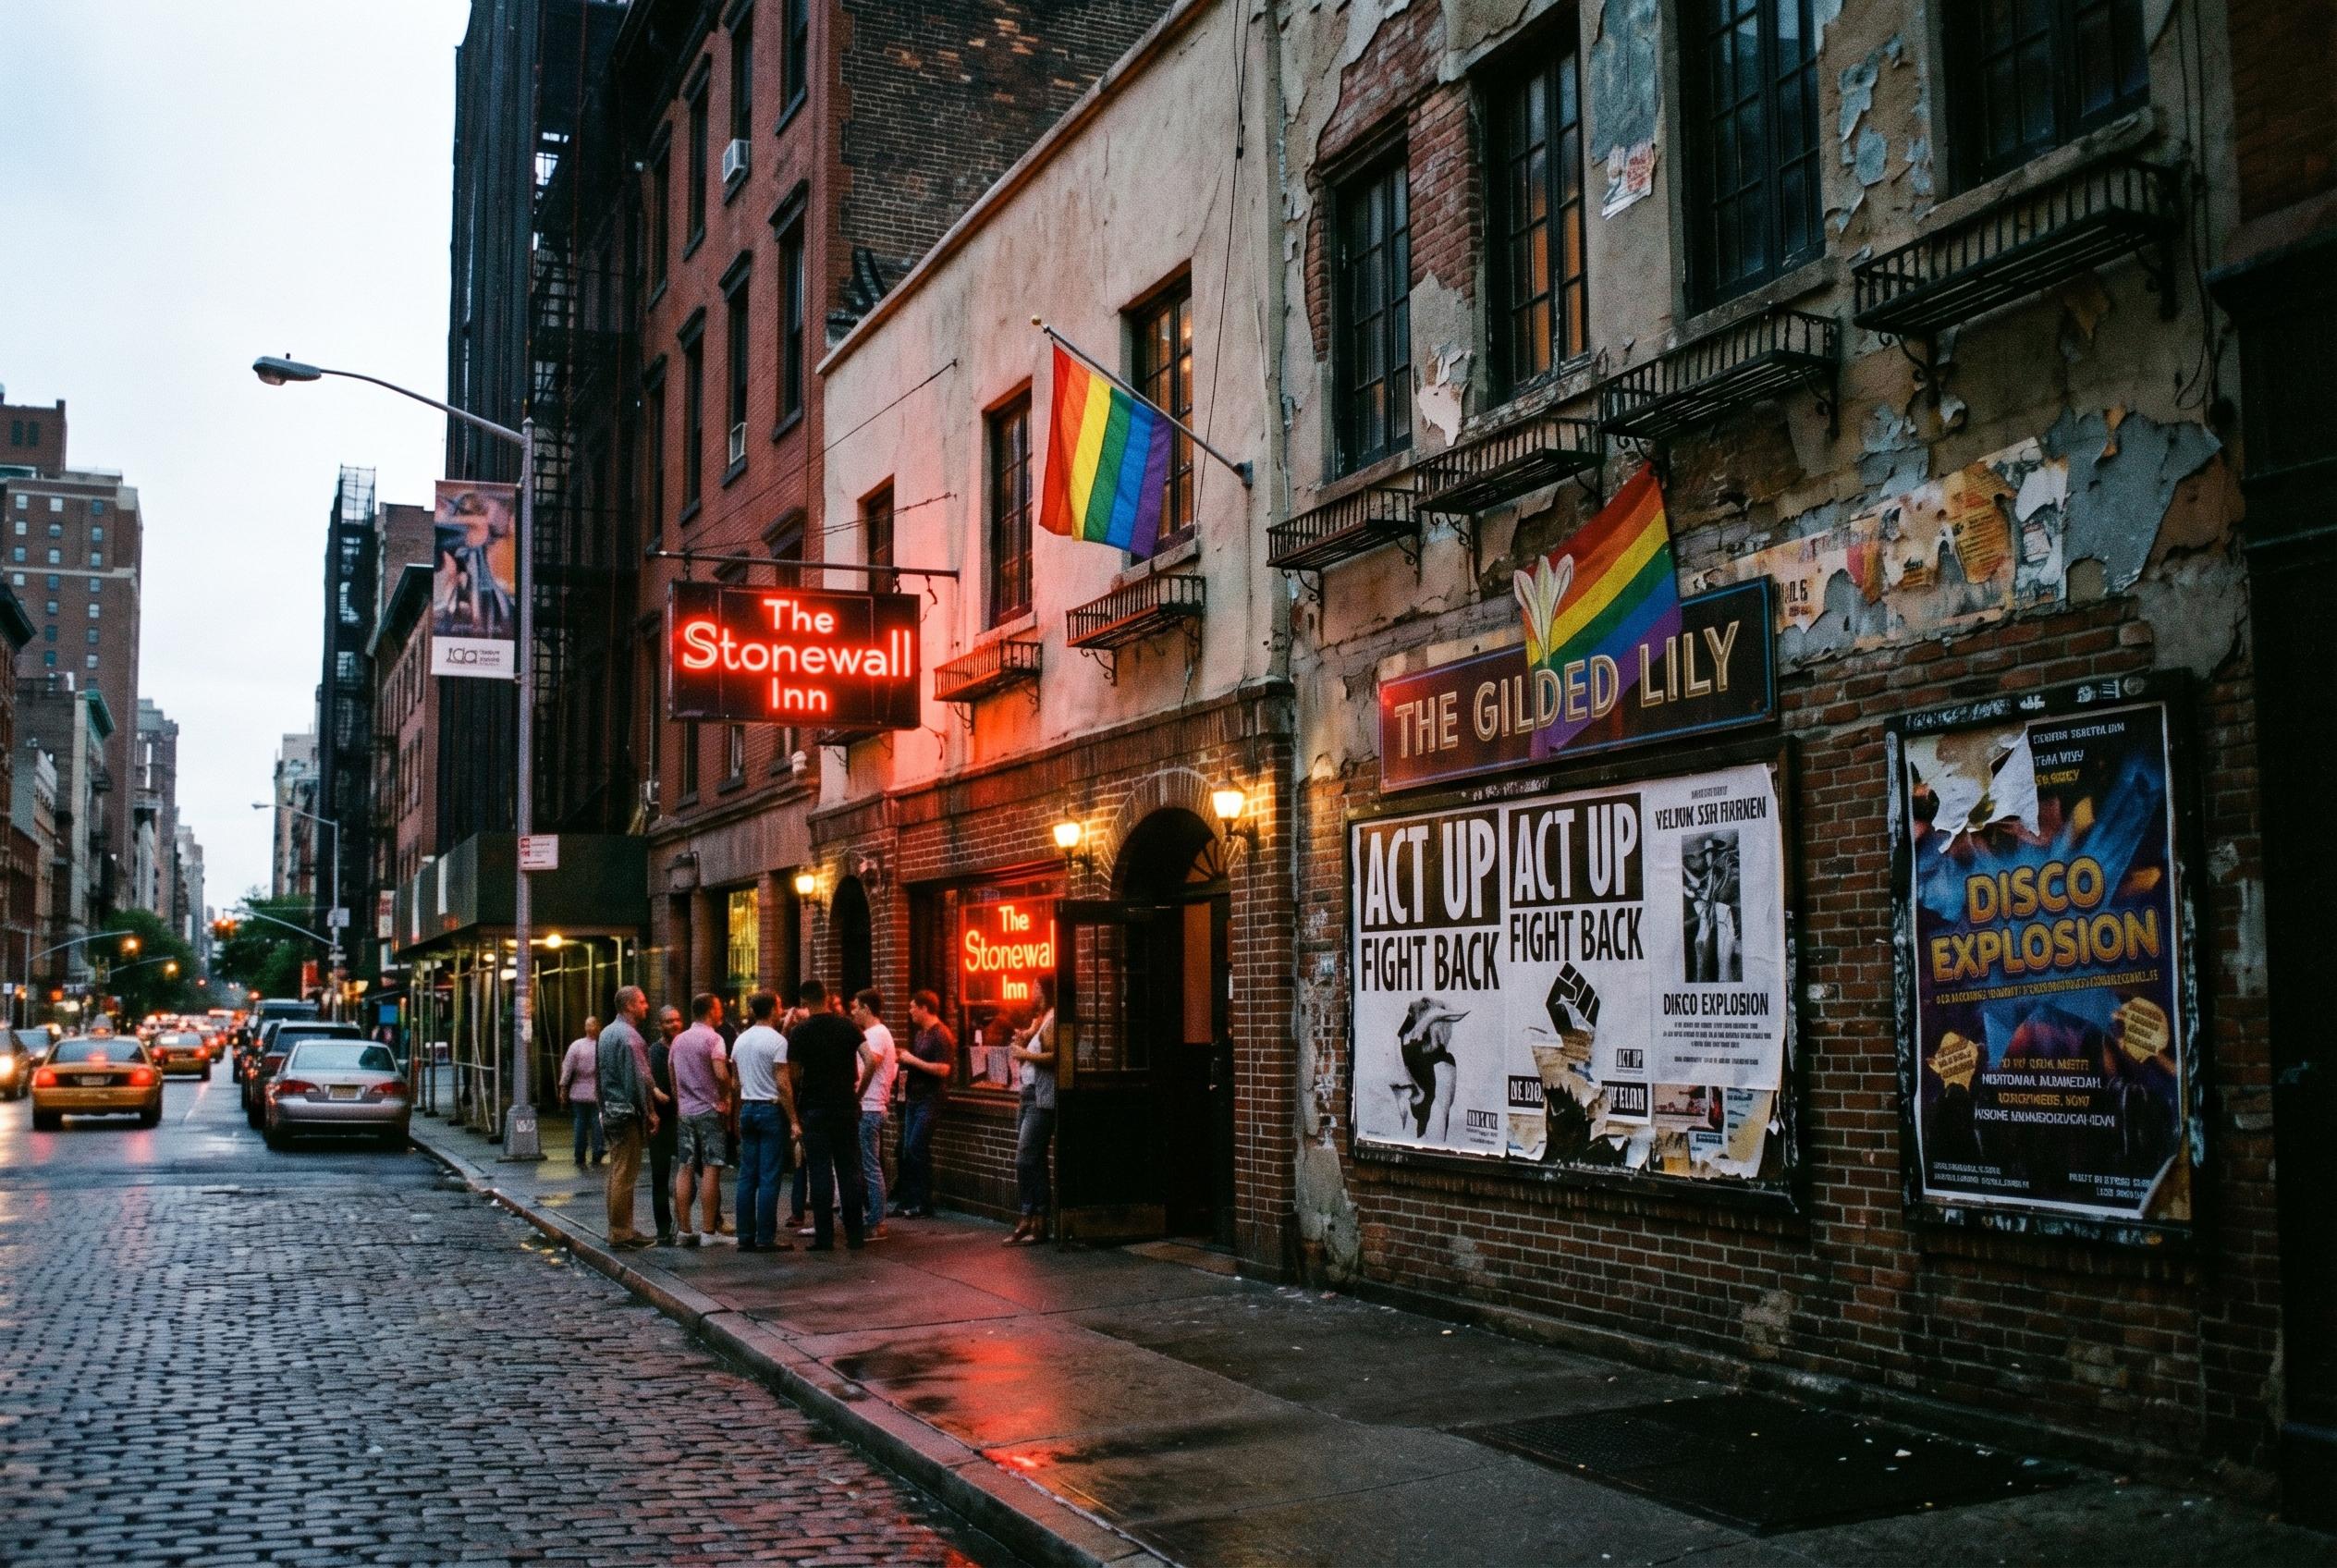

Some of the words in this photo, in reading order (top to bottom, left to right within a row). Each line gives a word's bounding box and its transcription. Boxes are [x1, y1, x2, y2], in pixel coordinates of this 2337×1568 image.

[763, 598, 835, 634] The
[682, 620, 912, 678] Stonewall
[771, 677, 827, 712] Inn
[1394, 691, 1459, 759] THE
[1473, 655, 1620, 741] GILDED
[1639, 619, 1740, 708] LILY
[1364, 825, 1429, 926] ACT
[1440, 819, 1497, 922] UP
[1513, 806, 1575, 902] ACT
[1587, 802, 1639, 898] UP
[998, 904, 1030, 933] The
[1965, 856, 2105, 924] DISCO
[1361, 935, 1427, 992] FIGHT
[1433, 931, 1500, 991] BACK
[1510, 910, 1574, 963] FIGHT
[1580, 907, 1644, 962] BACK
[1929, 908, 2161, 983] EXPLOSION
[1002, 974, 1028, 1000] Inn
[1702, 993, 1768, 1016] EXPLOSION
